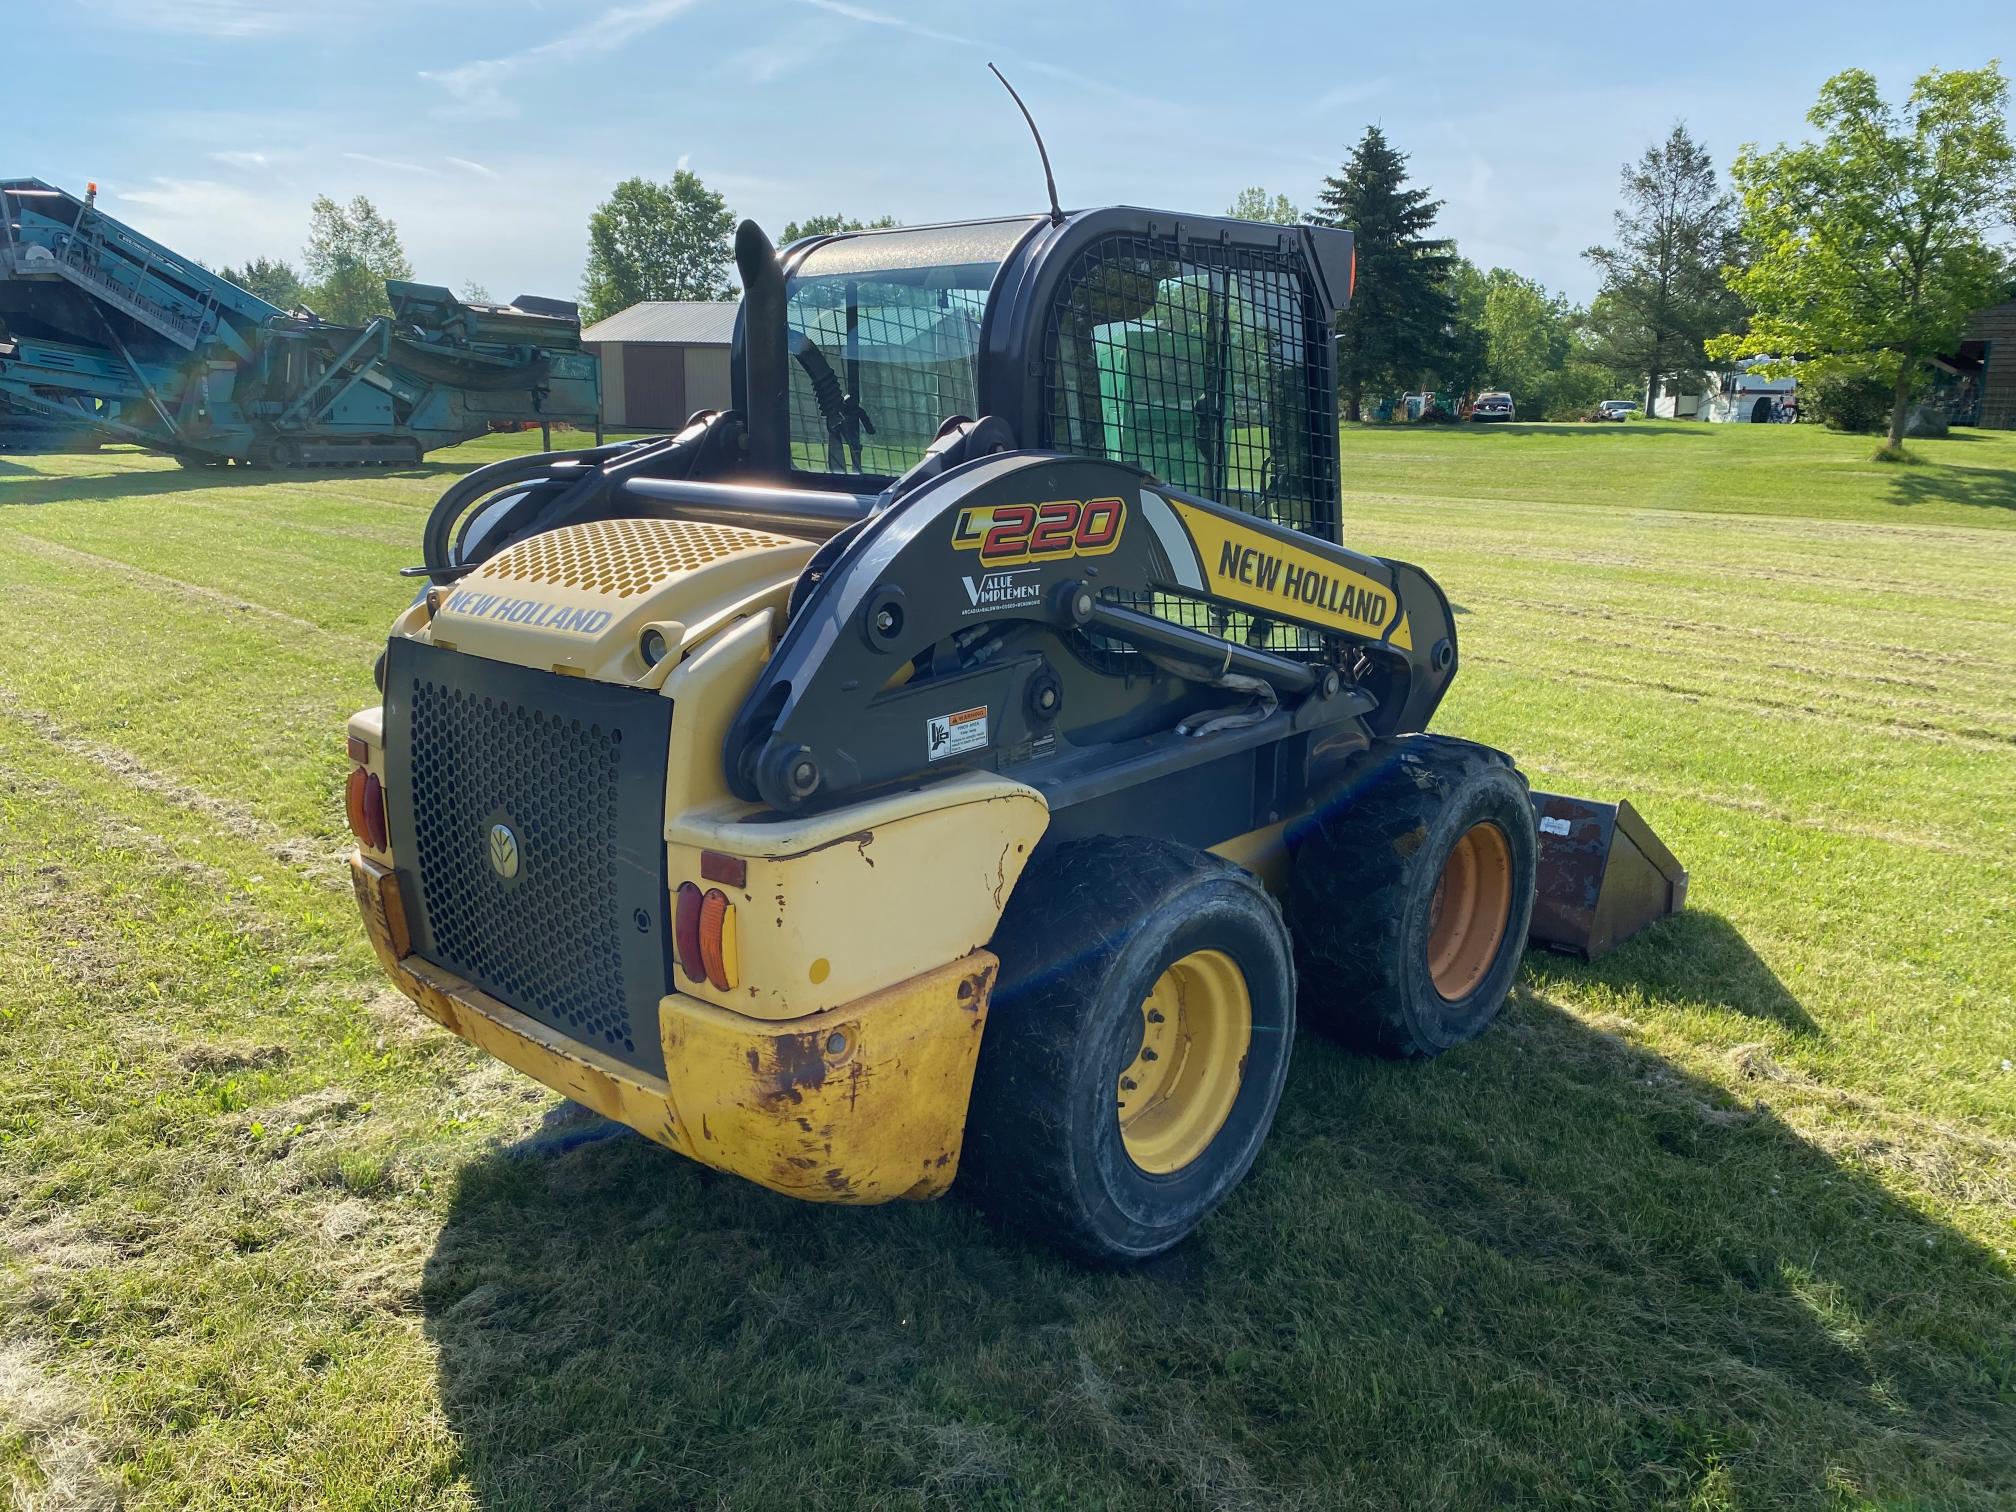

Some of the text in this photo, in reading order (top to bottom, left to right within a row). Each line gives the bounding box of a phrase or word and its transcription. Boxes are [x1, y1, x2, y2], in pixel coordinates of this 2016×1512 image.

[953, 498, 1125, 564] L220
[961, 575, 1014, 607] VALUE
[980, 585, 1041, 603] IMPLEMENT
[1218, 540, 1387, 627] NEW HOLLAND
[446, 591, 613, 634] NEW HOLLAND
[958, 710, 984, 722] WARNING
